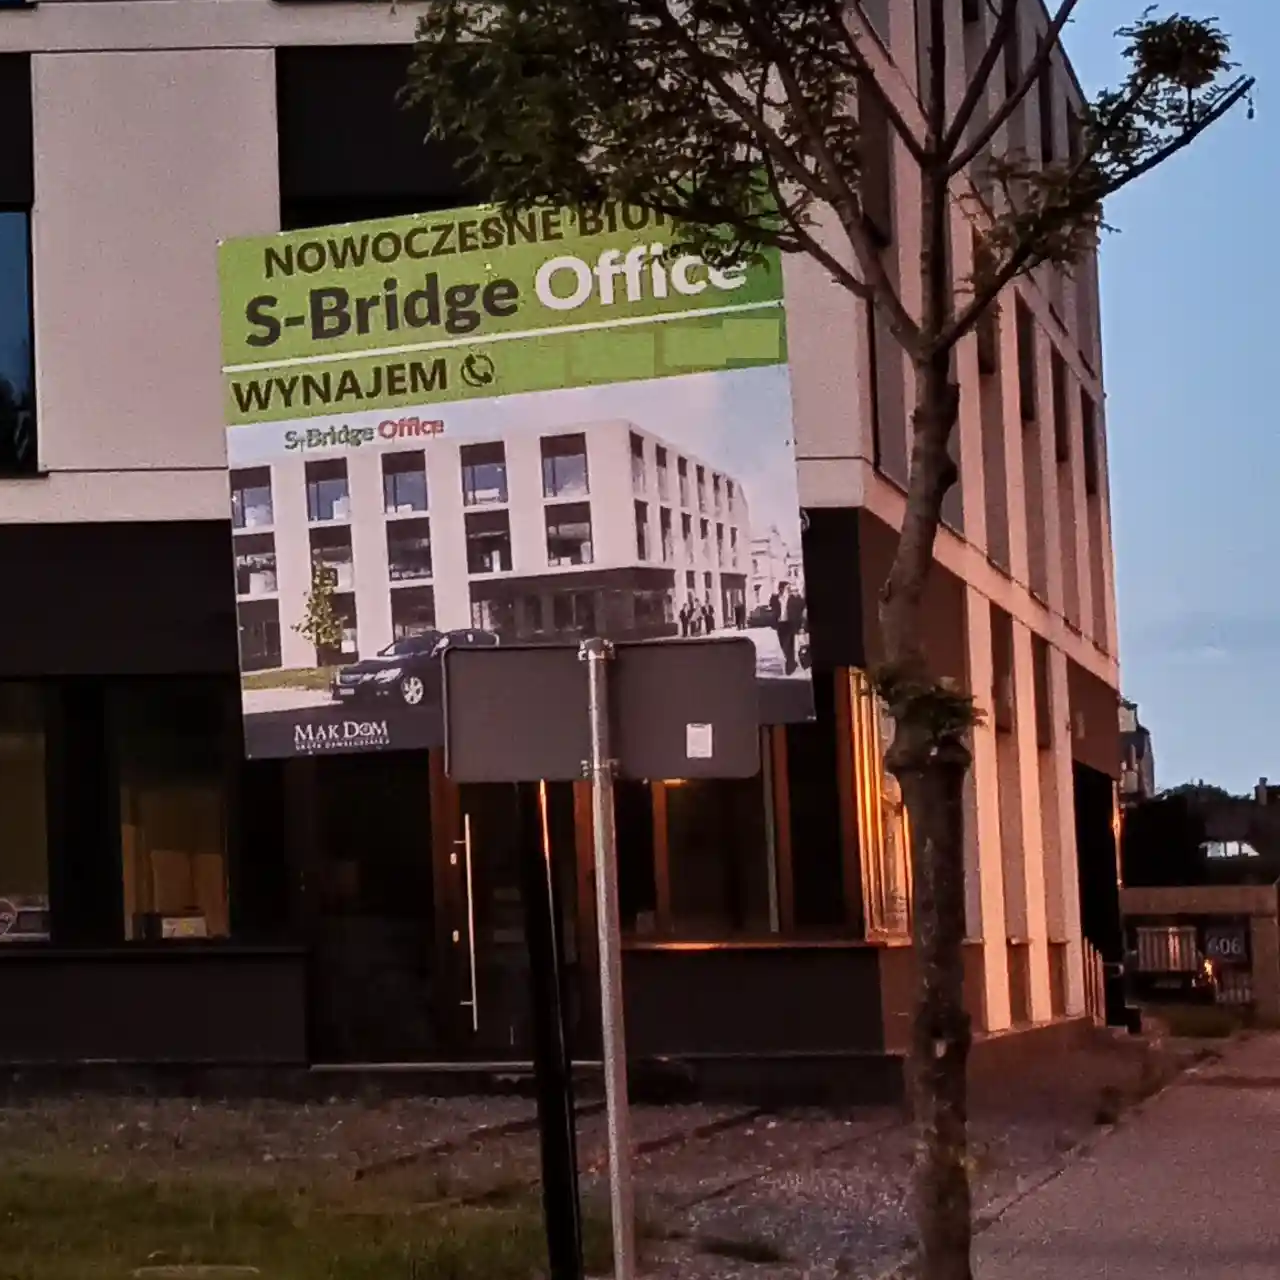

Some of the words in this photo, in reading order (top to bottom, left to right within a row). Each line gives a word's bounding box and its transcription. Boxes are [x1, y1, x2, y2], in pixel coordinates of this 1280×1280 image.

[264, 205, 564, 279] NOWOCZESNE
[244, 271, 519, 348] S-Bridge
[231, 357, 448, 413] WYNAJEM
